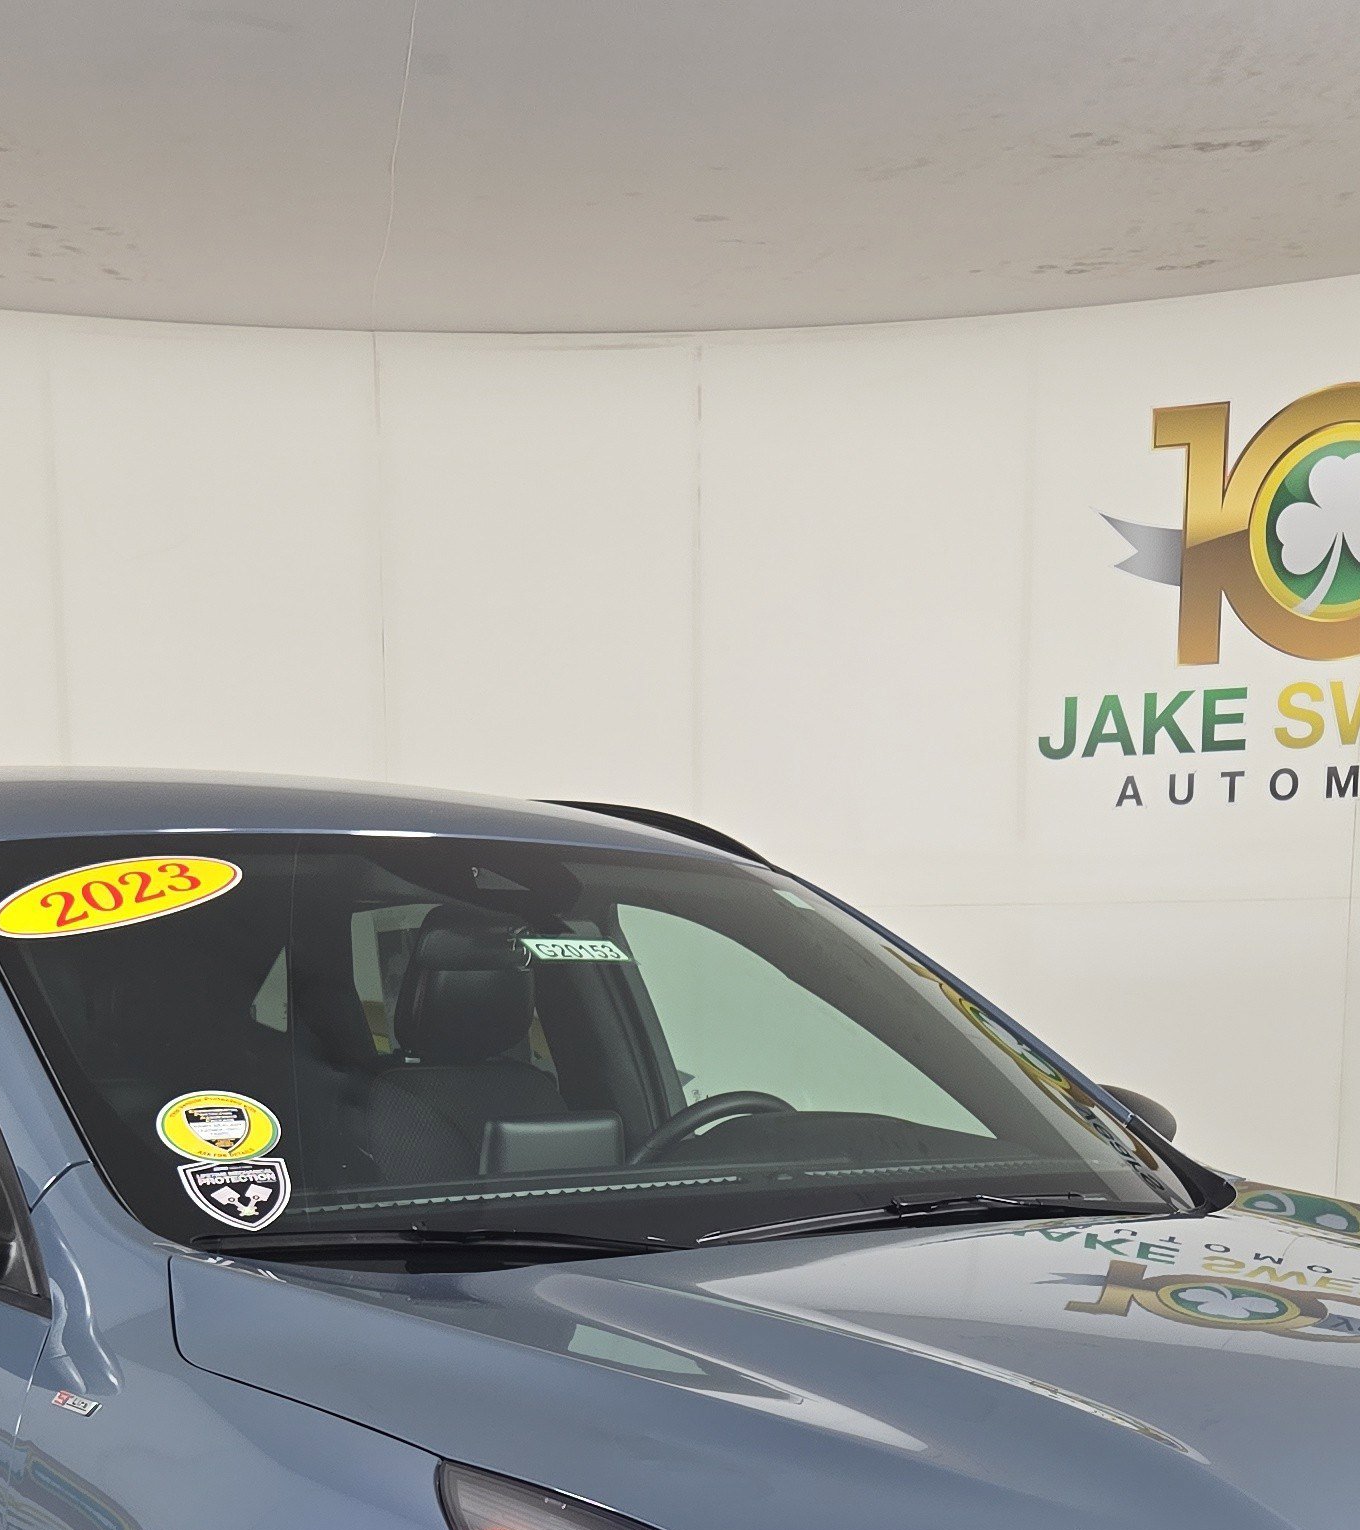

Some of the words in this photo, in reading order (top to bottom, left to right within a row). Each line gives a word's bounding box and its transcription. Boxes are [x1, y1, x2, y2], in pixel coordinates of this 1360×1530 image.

[1039, 686, 1248, 761] JAKE
[40, 862, 201, 928] 2023
[535, 943, 621, 959] G20153
